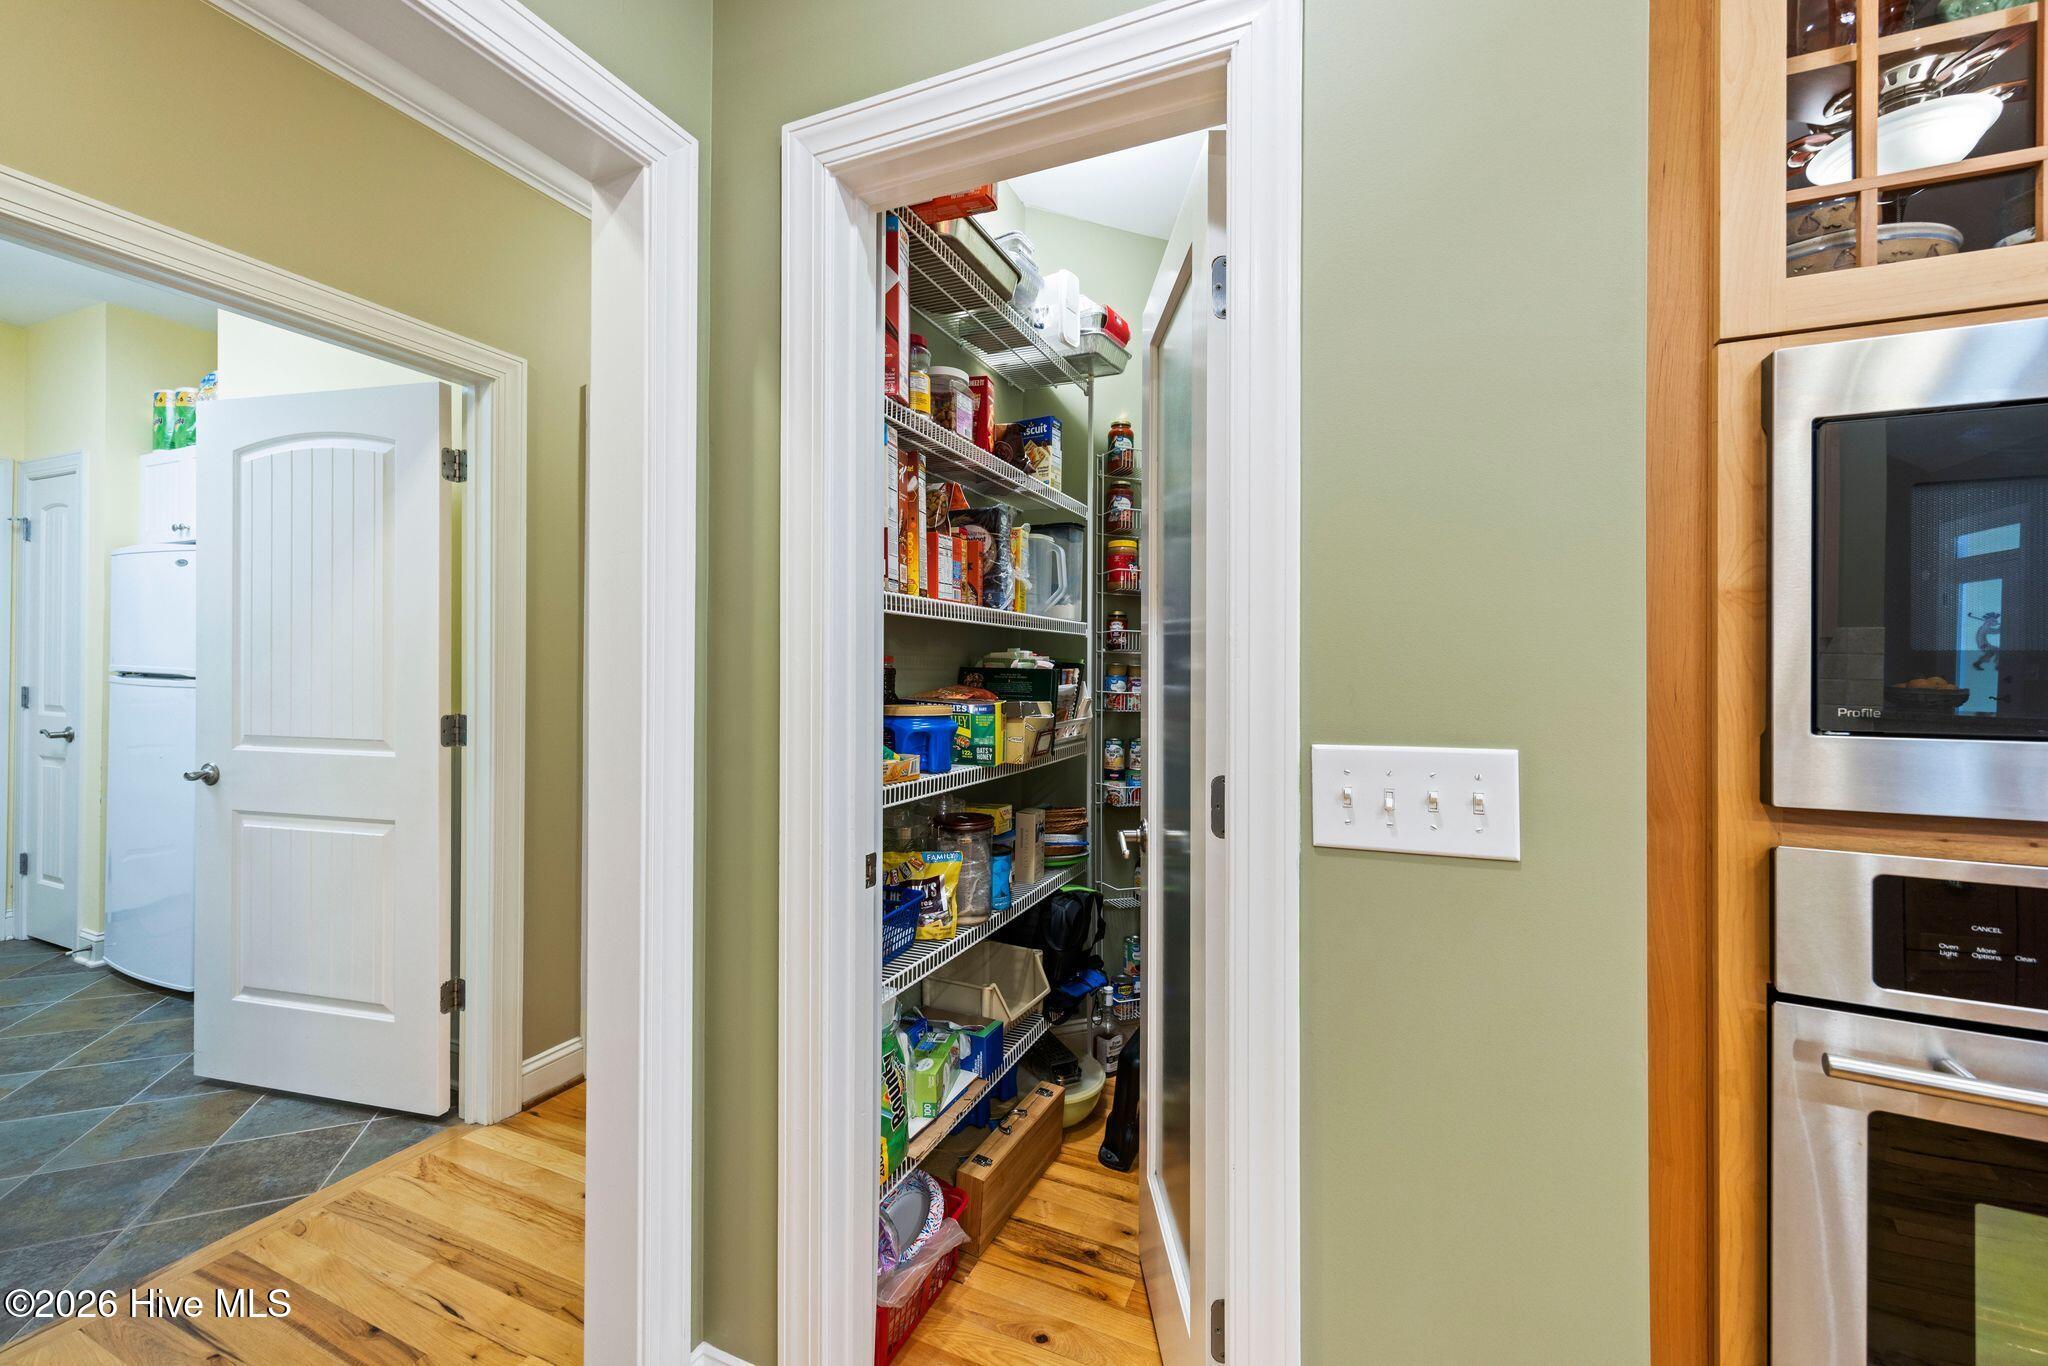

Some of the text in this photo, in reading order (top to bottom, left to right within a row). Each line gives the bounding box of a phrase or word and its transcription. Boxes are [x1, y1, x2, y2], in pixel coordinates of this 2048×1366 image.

[1837, 707, 1882, 718] Profile
[926, 852, 954, 861] FAMILY
[1971, 925, 2003, 934] CANCEL
[1938, 942, 1959, 951] Oven
[1976, 946, 1997, 954] More
[1939, 949, 1959, 960] Light
[1971, 952, 2003, 962] Options
[2014, 954, 2037, 963] Clean
[882, 1050, 906, 1131] Bounty
